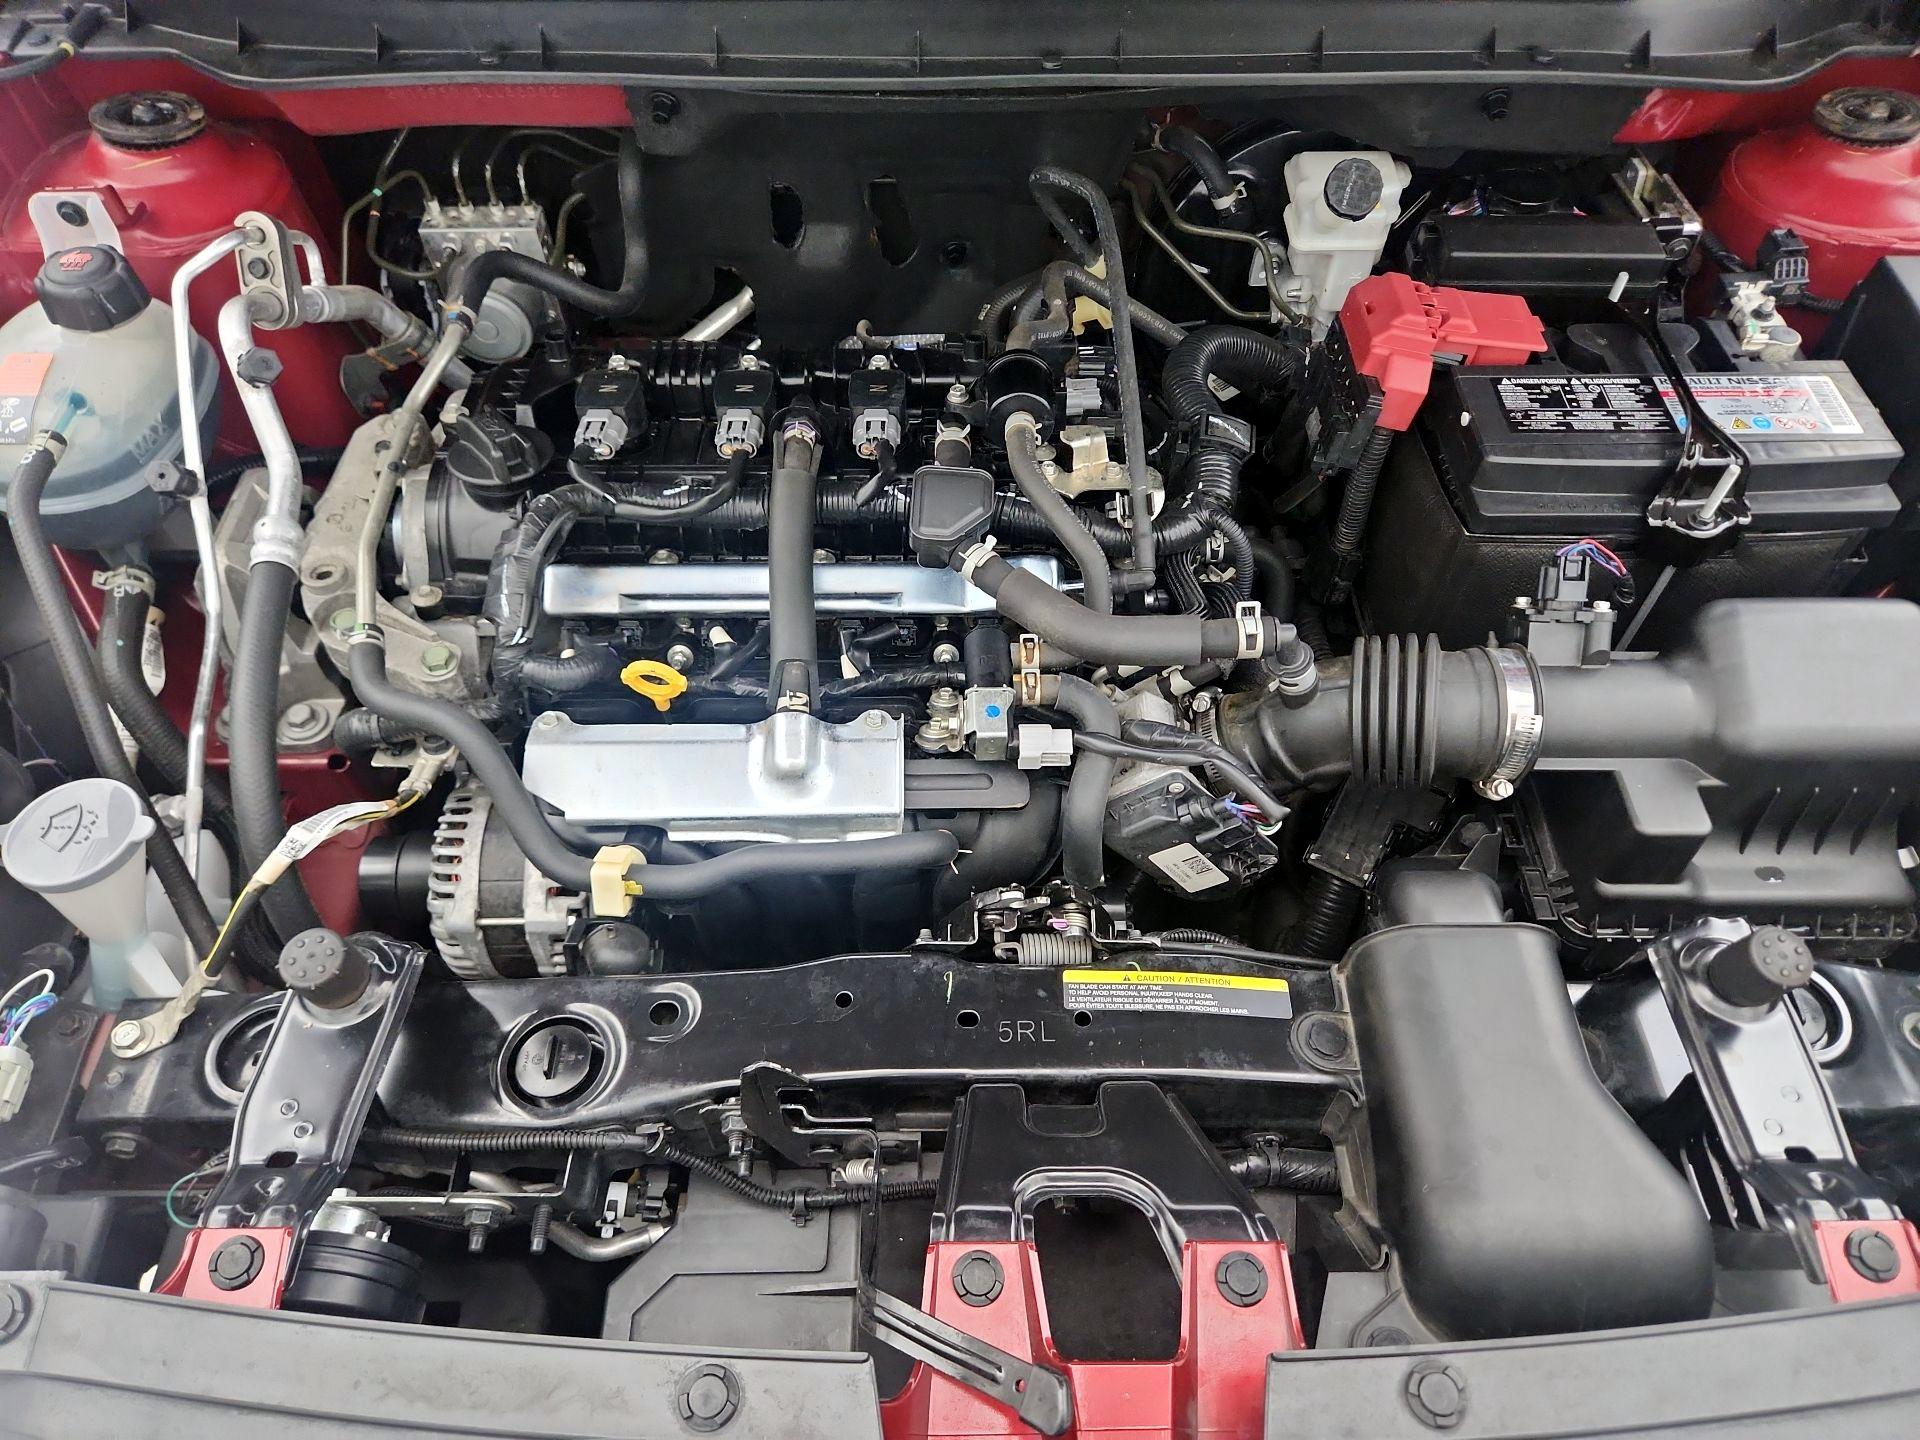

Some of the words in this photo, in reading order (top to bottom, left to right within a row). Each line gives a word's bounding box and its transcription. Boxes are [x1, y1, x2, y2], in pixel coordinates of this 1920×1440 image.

[1659, 377, 1722, 386] RAULT
[1136, 974, 1175, 983] CAUTION
[1184, 976, 1231, 986] ATTENTION
[999, 1020, 1056, 1042] 5RL
